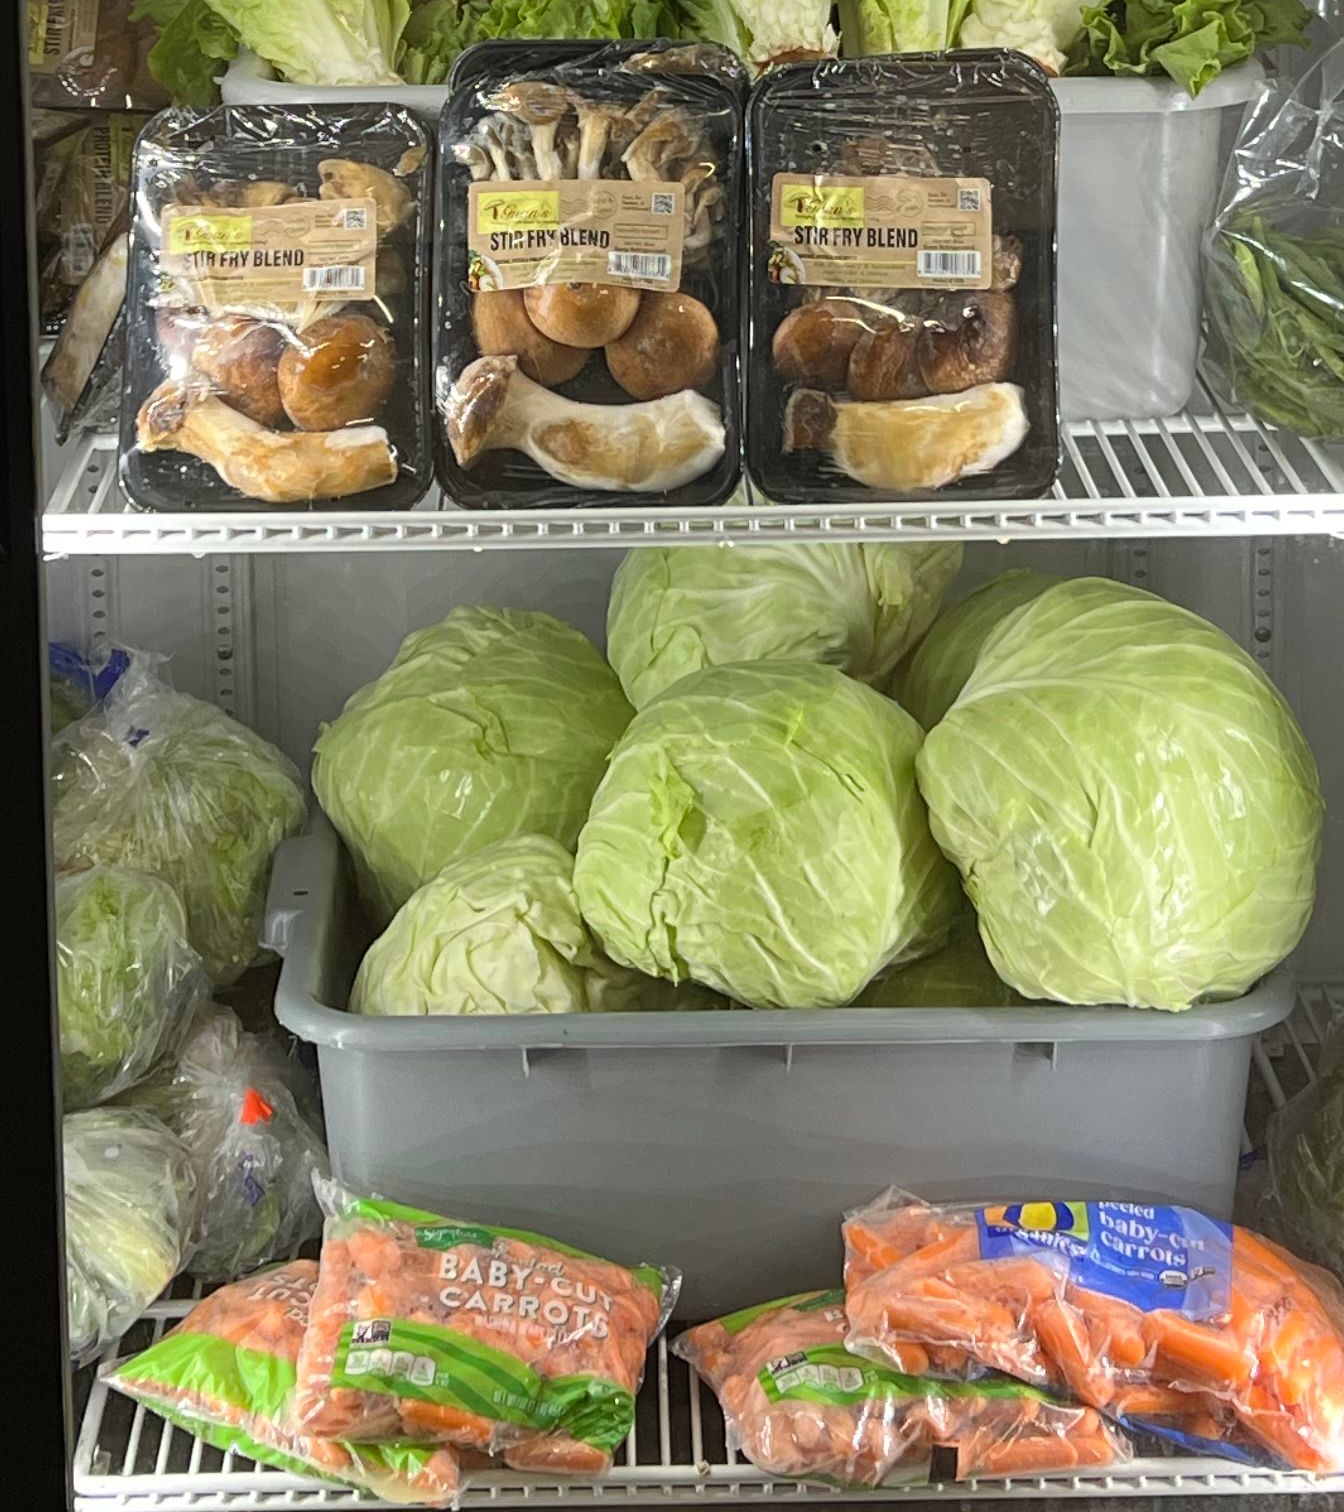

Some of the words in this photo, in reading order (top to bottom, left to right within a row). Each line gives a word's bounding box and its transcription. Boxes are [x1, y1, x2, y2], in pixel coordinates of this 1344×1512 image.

[490, 230, 524, 251] STIR
[527, 229, 558, 248] FRY
[560, 227, 610, 248] BLEND
[794, 226, 829, 246] STIR
[833, 227, 863, 247] FRY
[867, 228, 918, 249] BLEND
[219, 249, 251, 268] FRY
[253, 248, 304, 267] BLEND
[1100, 1230, 1187, 1267] carrots
[439, 1252, 614, 1312] BABY-CUT
[439, 1286, 609, 1338] CARROTS
